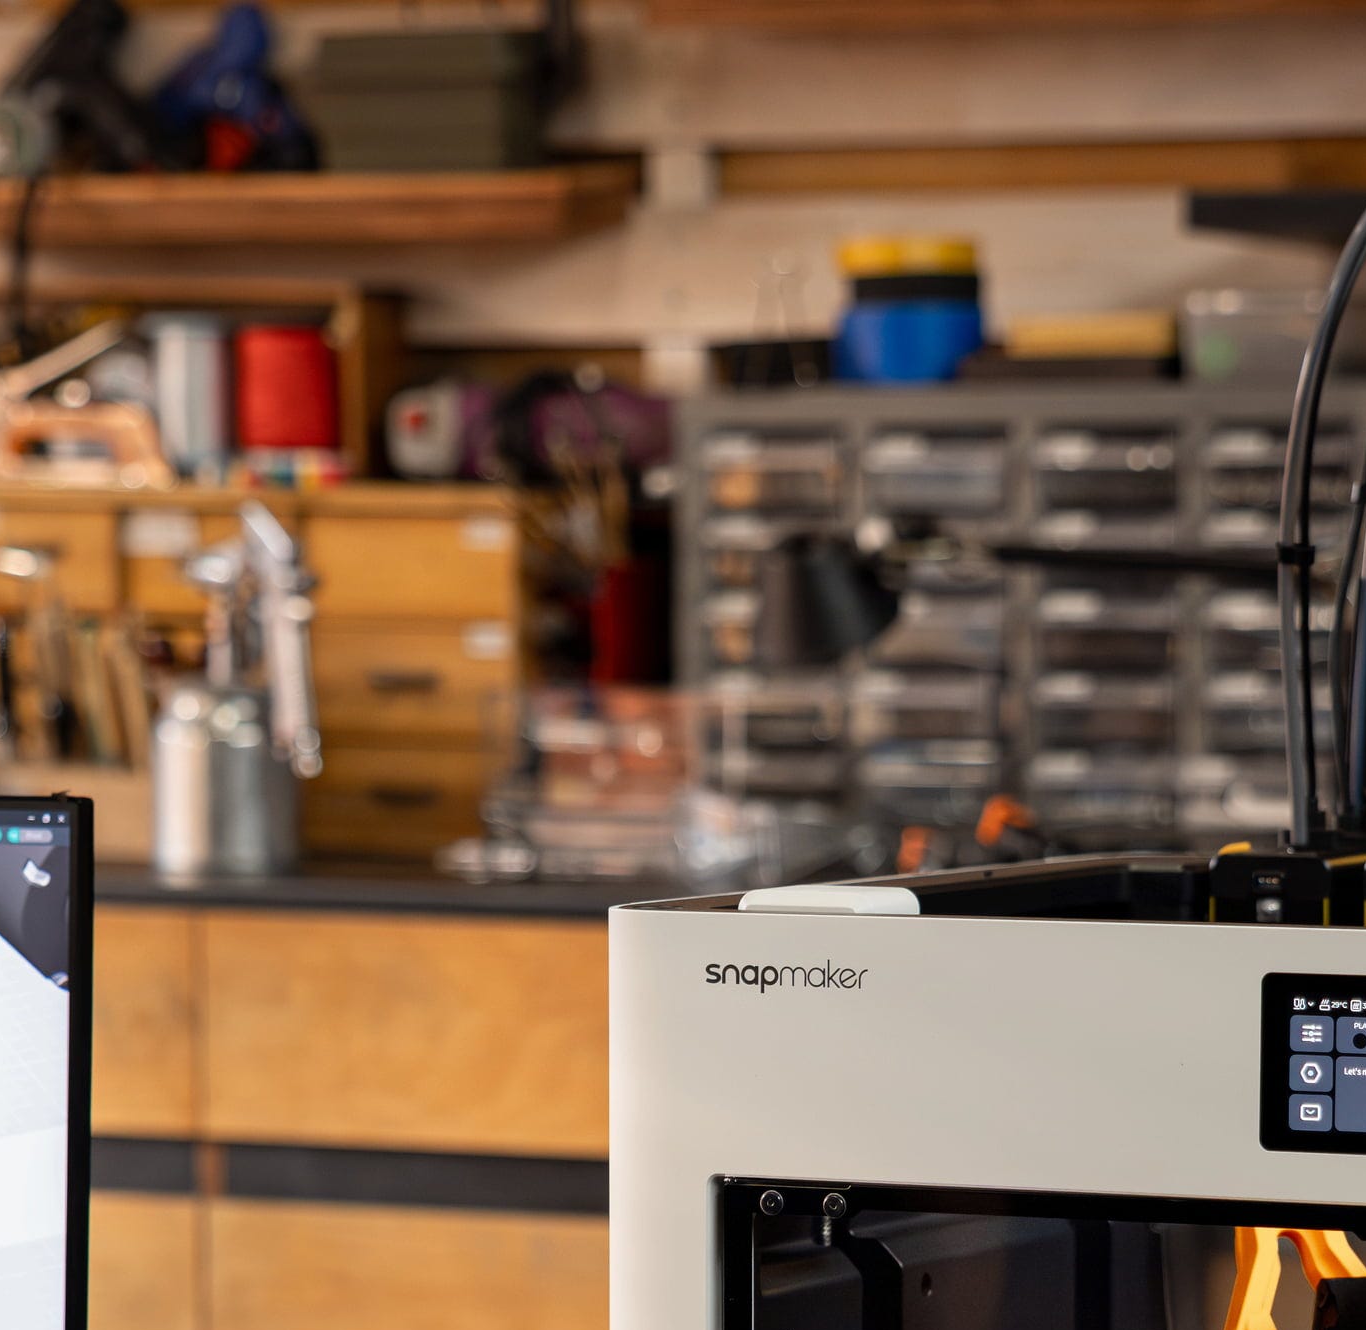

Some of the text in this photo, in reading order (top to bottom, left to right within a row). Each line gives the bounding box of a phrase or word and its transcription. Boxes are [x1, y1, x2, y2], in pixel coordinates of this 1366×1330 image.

[705, 959, 868, 994] snapmaker
[1331, 1001, 1348, 1009] 29°C
[1344, 1067, 1361, 1076] Let's
